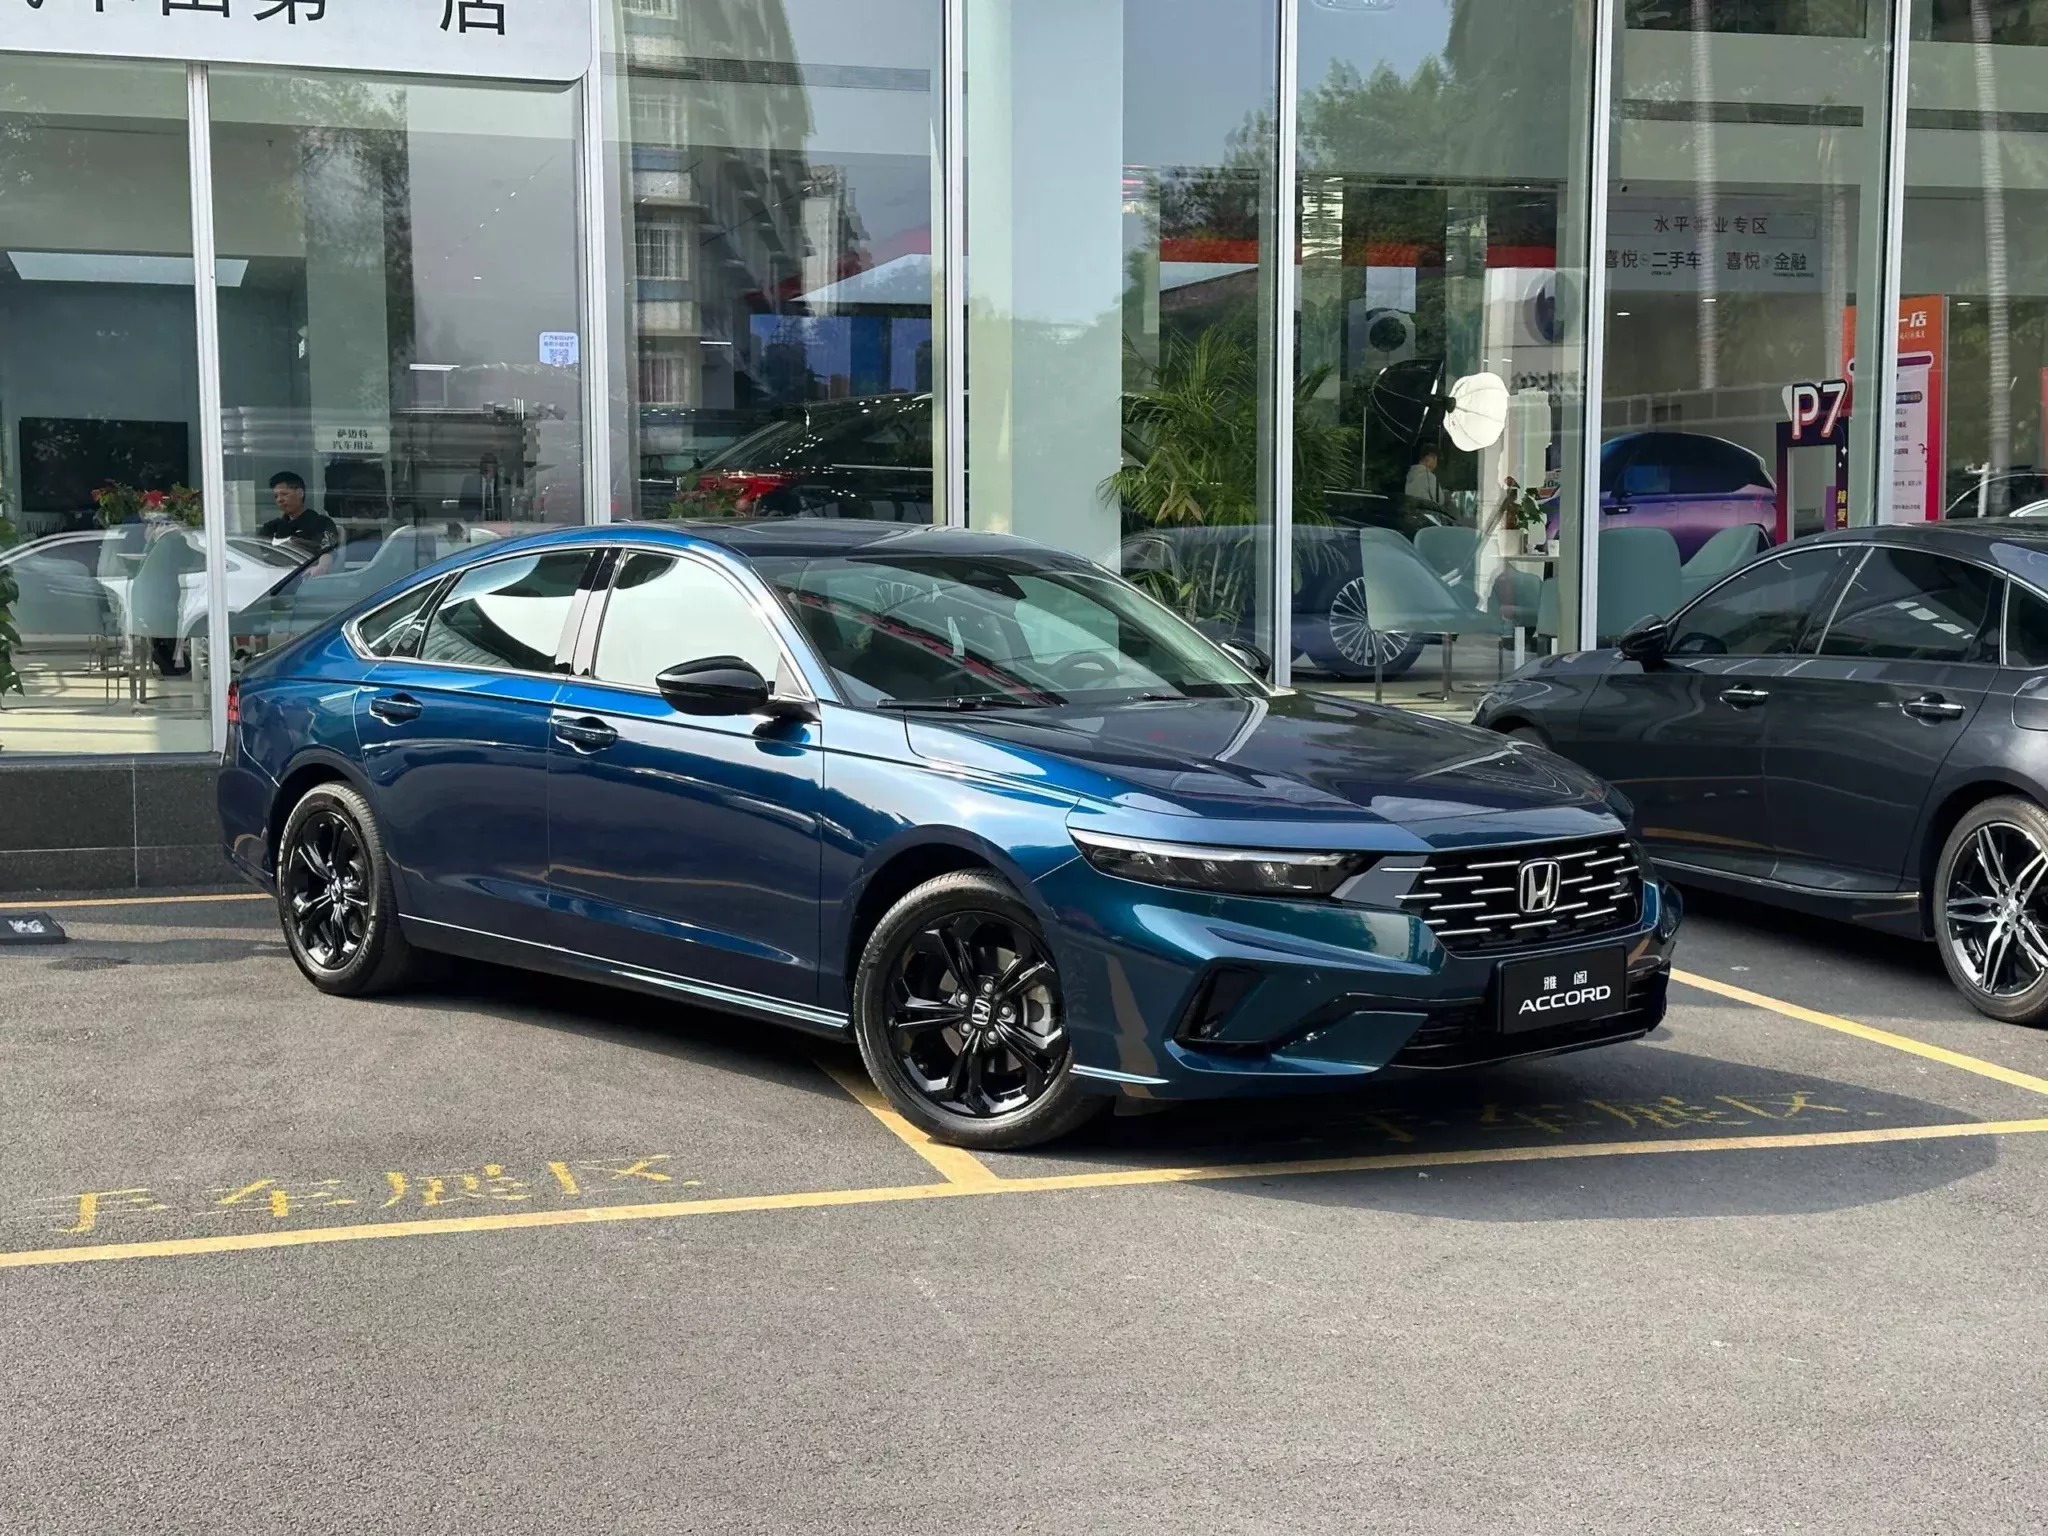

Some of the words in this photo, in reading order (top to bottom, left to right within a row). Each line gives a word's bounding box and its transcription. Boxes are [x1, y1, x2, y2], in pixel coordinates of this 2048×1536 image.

[1652, 250, 1702, 270] 二手车
[1726, 251, 1761, 271] 喜悦
[1774, 252, 1808, 272] 金融
[1791, 380, 1848, 440] P7
[1543, 970, 1588, 991] 雅阁
[1518, 985, 1611, 1015] ACCORD
